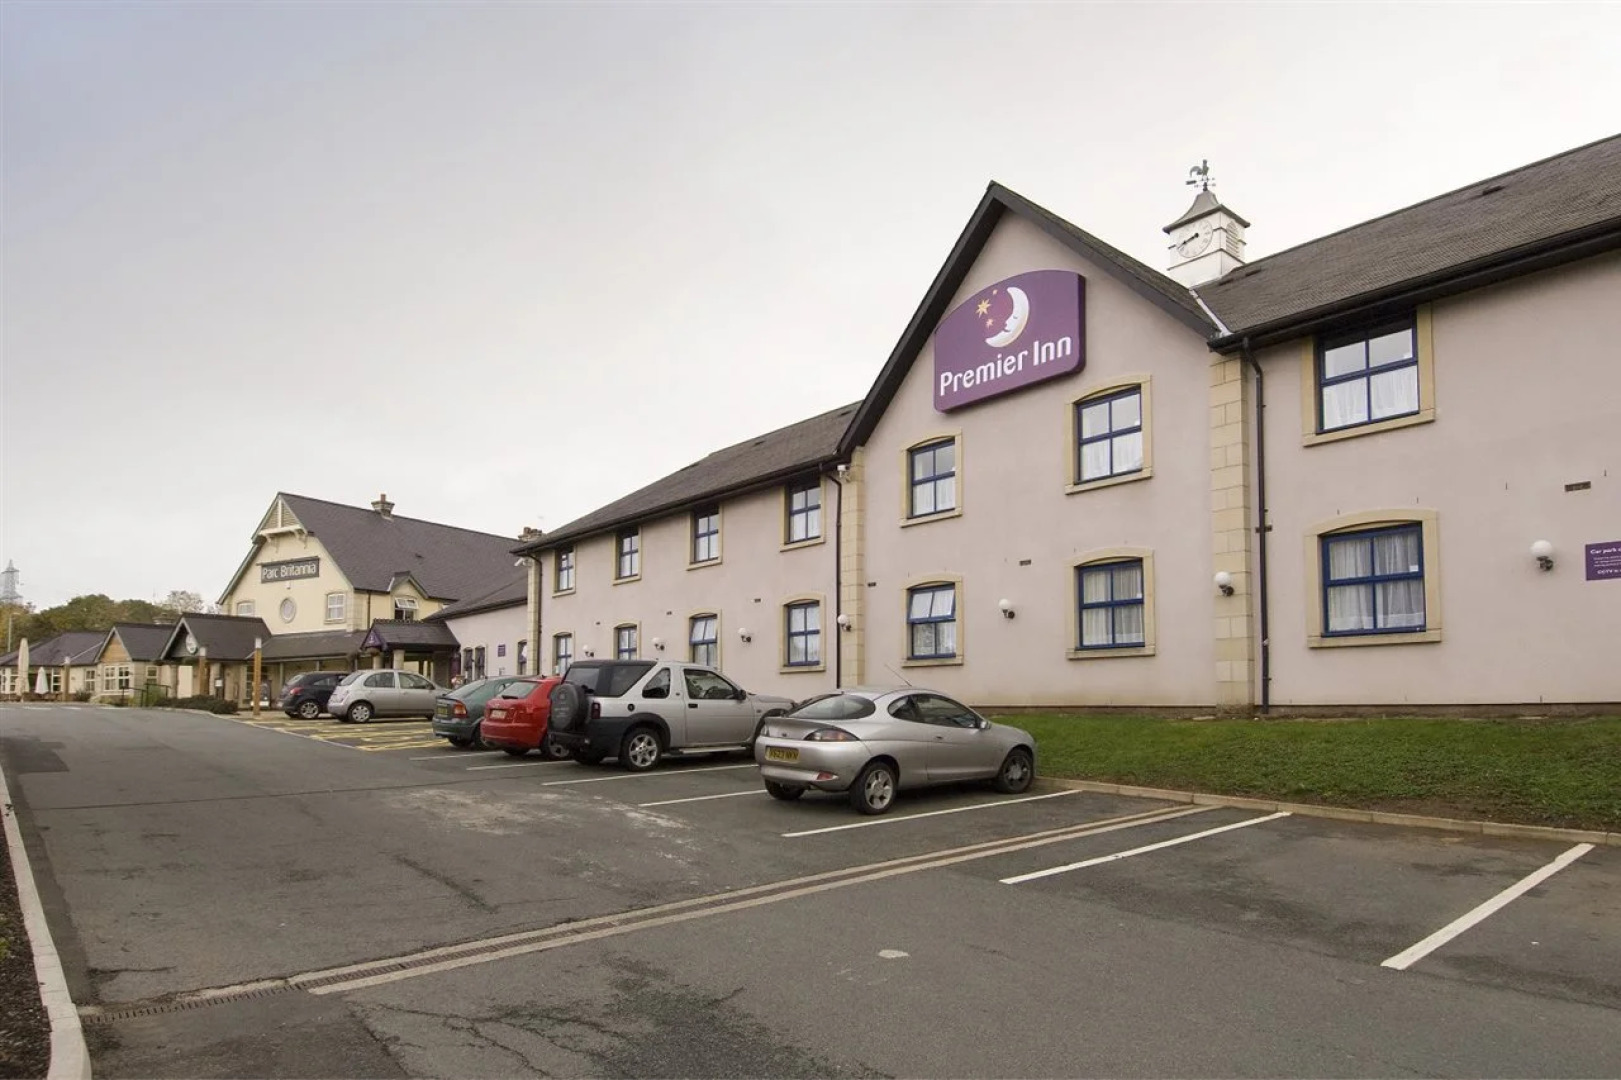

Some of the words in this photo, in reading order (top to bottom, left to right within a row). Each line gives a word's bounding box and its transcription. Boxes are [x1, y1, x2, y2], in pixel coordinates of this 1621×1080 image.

[940, 350, 1028, 396] Premier
[1033, 336, 1071, 366] Inn
[262, 567, 279, 580] Parc
[280, 563, 316, 578] Britannia
